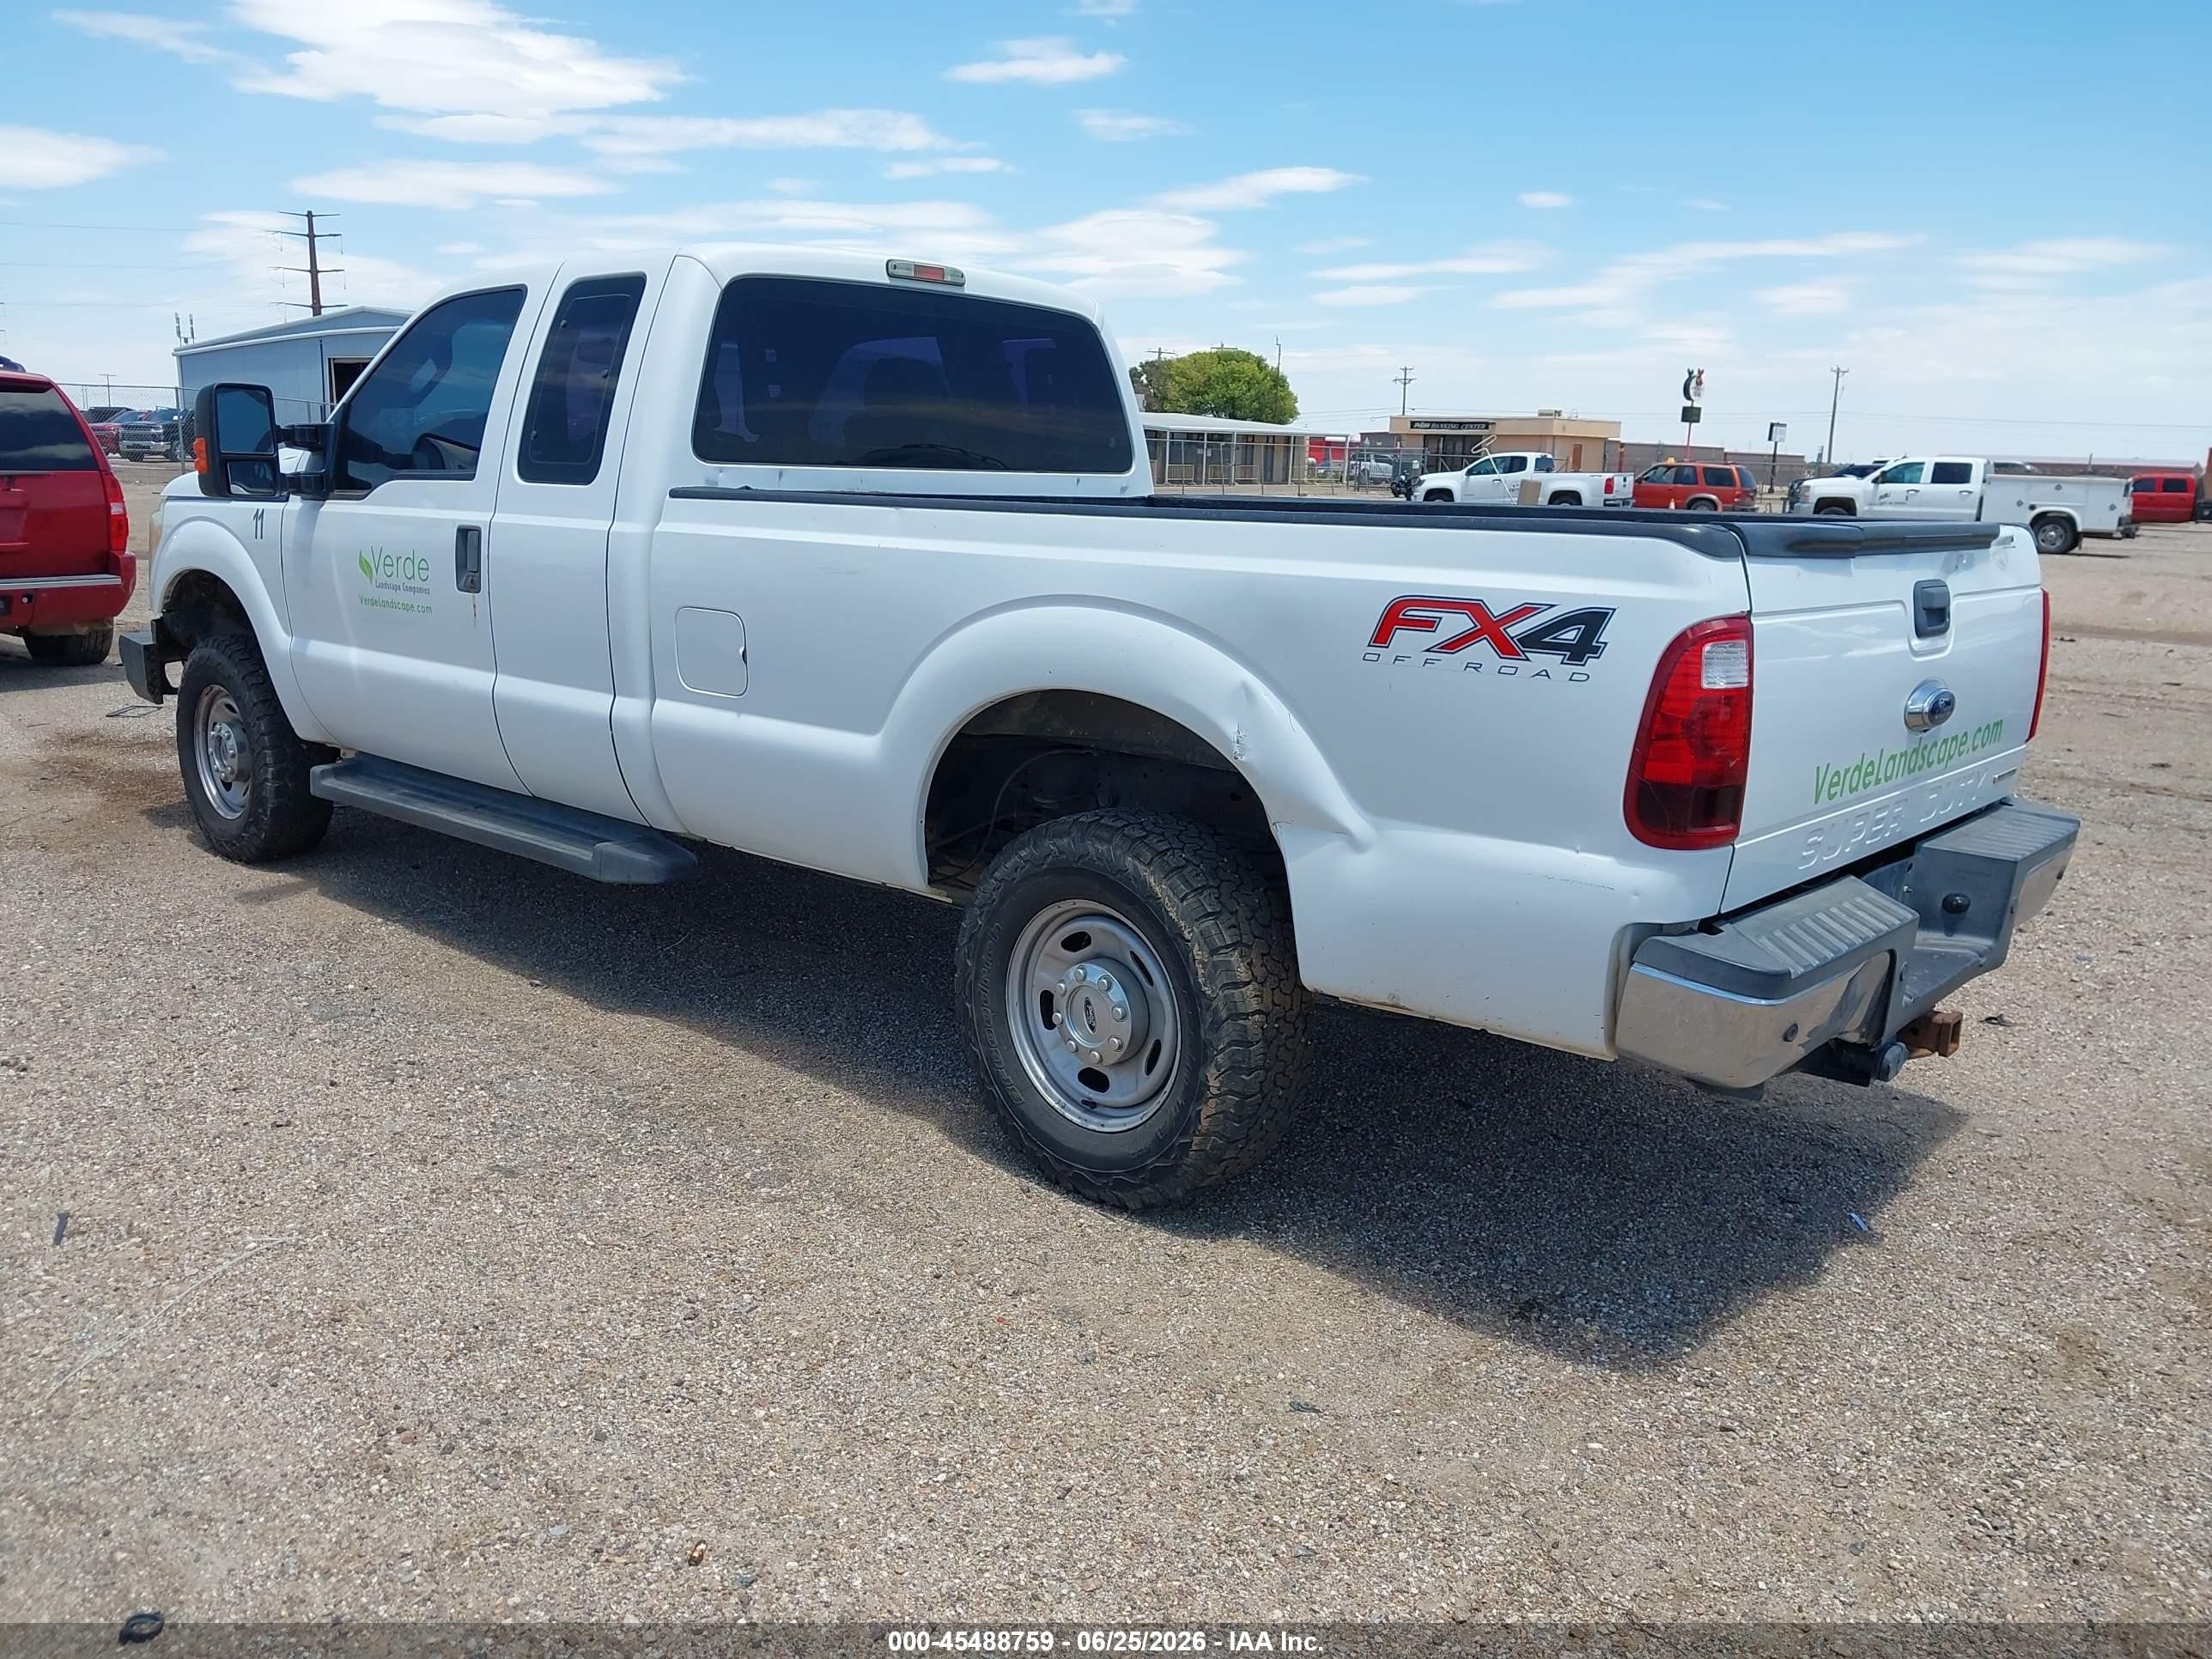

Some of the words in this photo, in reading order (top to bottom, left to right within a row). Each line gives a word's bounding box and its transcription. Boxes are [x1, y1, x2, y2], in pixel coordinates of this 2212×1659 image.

[252, 507, 265, 540] 11
[370, 545, 430, 582] Verde
[358, 594, 433, 615] VerdeLandscape.com
[375, 579, 401, 592] Landscape
[402, 582, 430, 595] Companies
[1366, 594, 1617, 667] FX4
[1362, 653, 1443, 667] OFF
[1463, 662, 1590, 683] ROAD
[1814, 719, 2004, 805] VerdeLandscape.com
[1797, 797, 1909, 871] SUPER
[1918, 770, 1988, 823] DUTY
